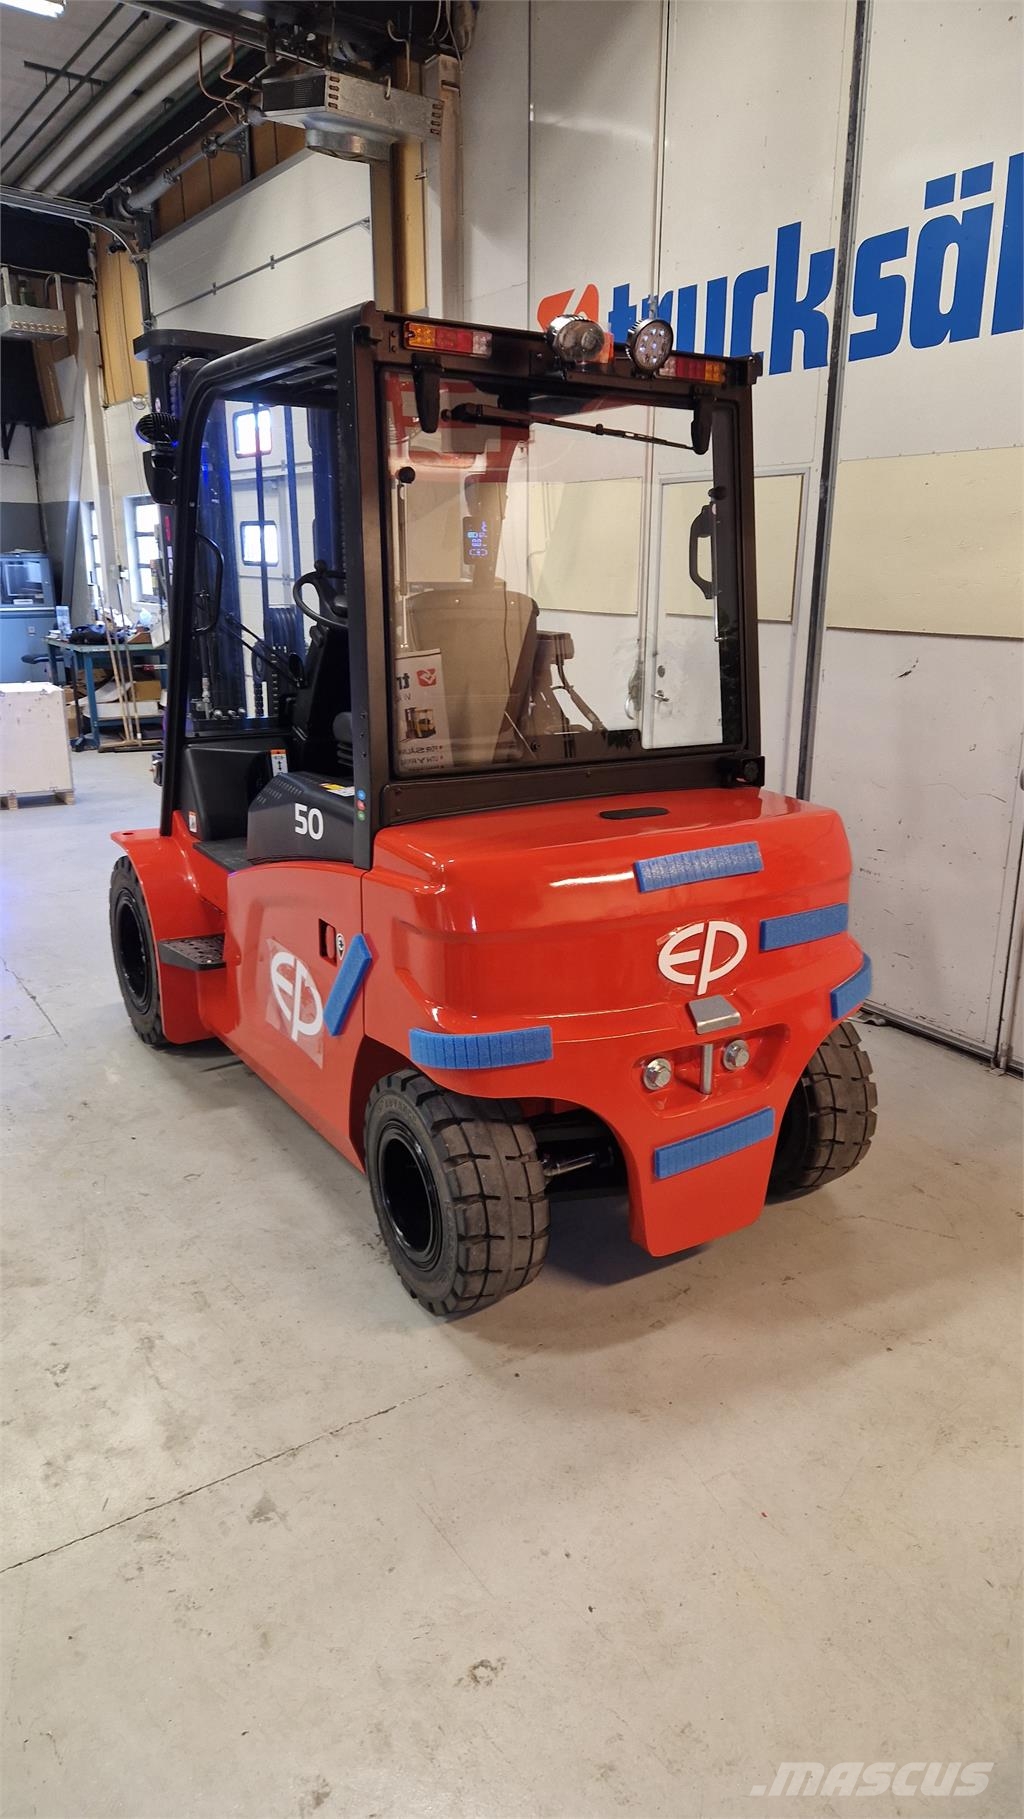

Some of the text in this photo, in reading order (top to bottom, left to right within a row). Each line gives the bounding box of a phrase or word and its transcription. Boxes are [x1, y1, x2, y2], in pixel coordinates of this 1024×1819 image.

[295, 803, 324, 840] 50
[658, 921, 748, 995] EP
[271, 951, 324, 1042] EP
